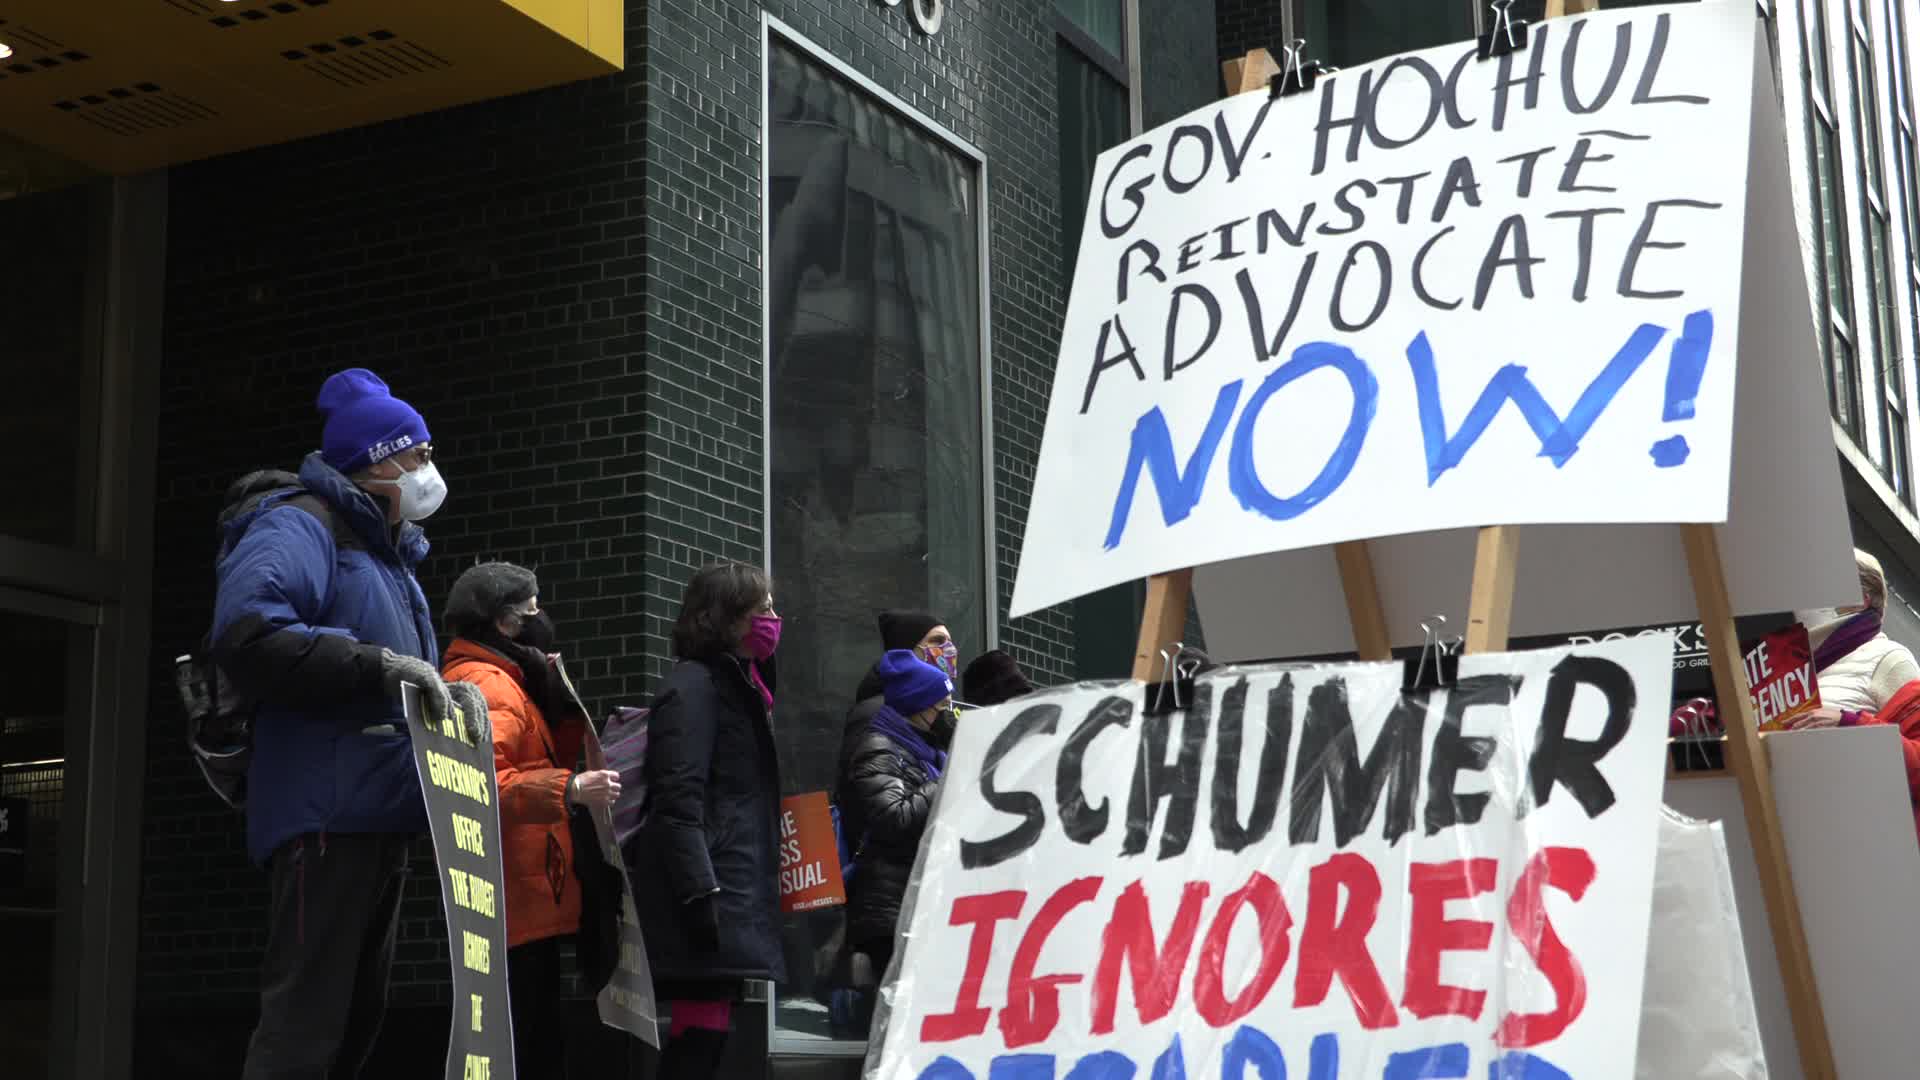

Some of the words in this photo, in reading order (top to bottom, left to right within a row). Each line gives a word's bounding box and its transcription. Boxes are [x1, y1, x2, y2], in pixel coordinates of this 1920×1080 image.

[1100, 97, 1274, 238] GOV.
[1311, 13, 1710, 176] HOCHUL
[1117, 129, 1652, 304] REINSTATE
[1080, 200, 1723, 415] ADVOCATE
[390, 435, 413, 453] LIES
[1104, 308, 1713, 552] NOW!
[451, 812, 486, 858] OFFICE
[960, 654, 1638, 870] SCHUMER
[448, 867, 471, 909] THE
[779, 861, 828, 896] SUAL
[920, 846, 1598, 1049] IGNORES
